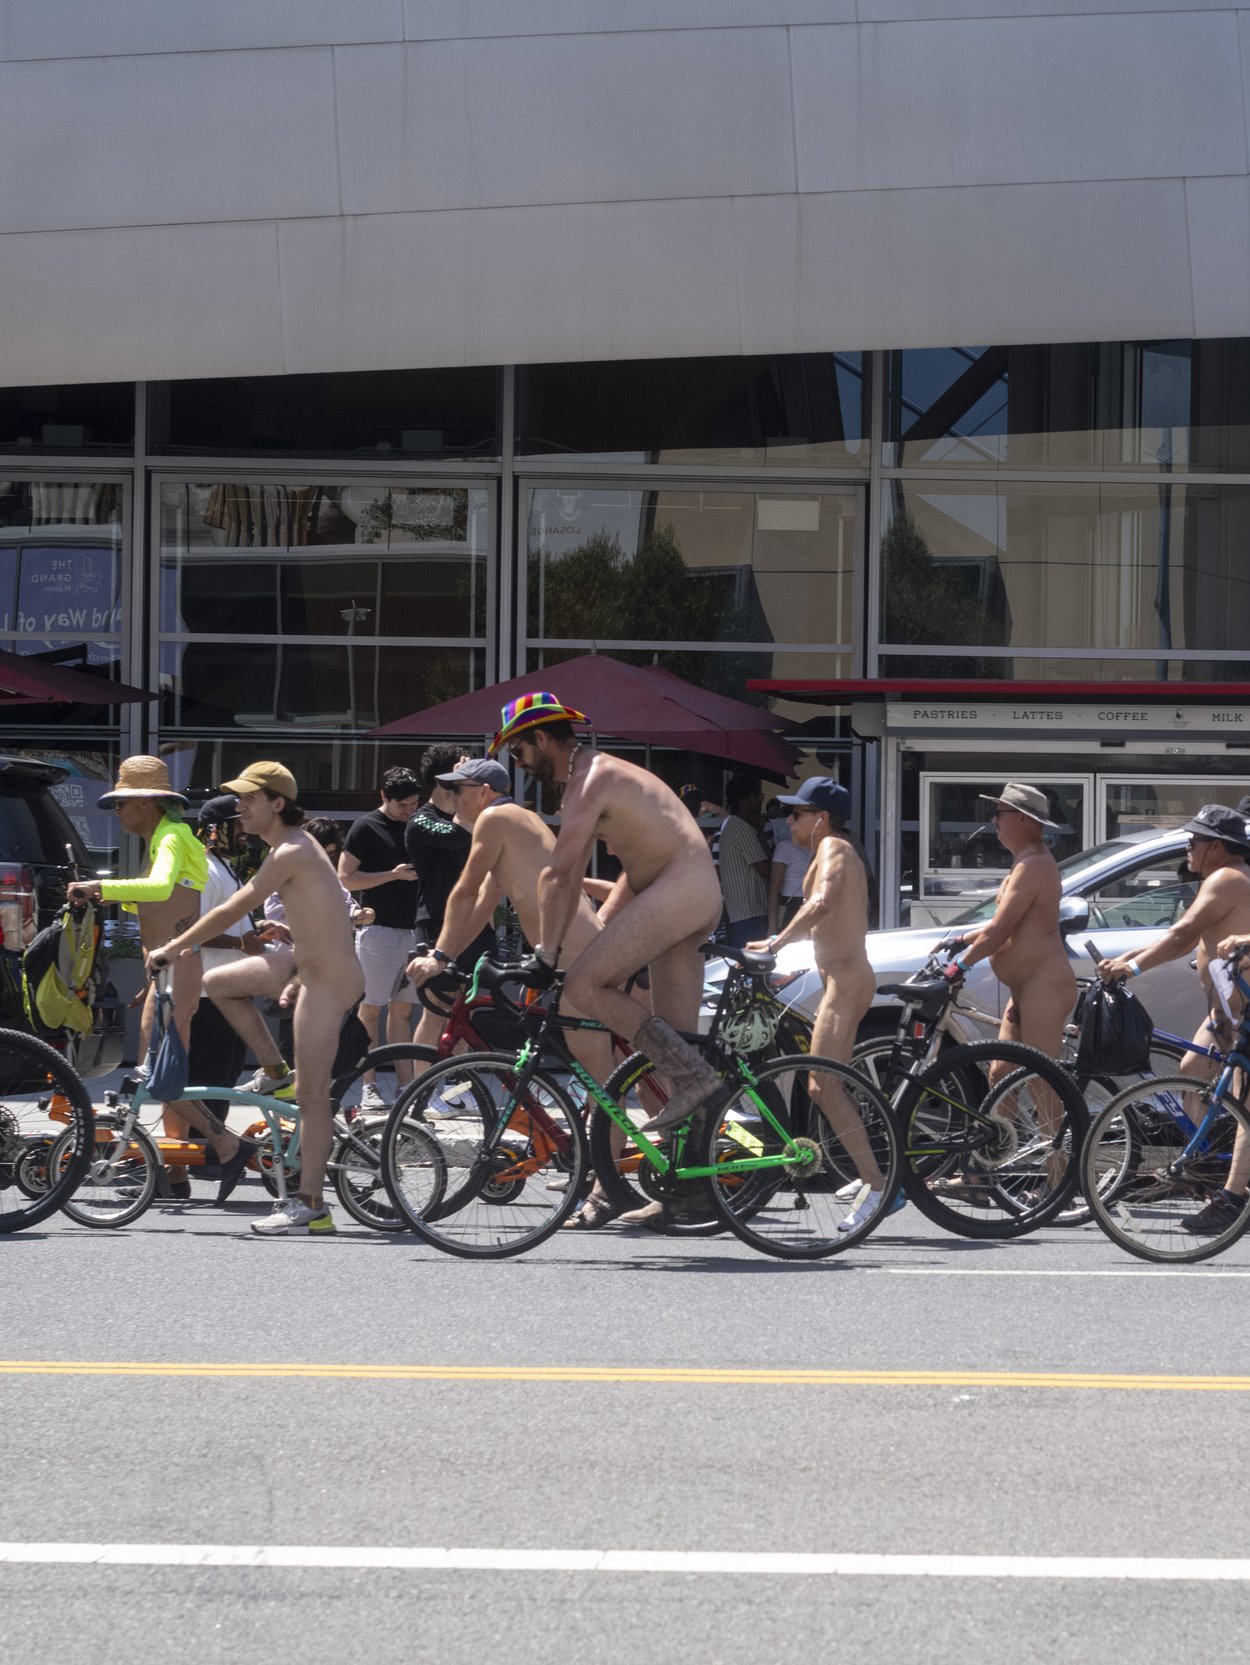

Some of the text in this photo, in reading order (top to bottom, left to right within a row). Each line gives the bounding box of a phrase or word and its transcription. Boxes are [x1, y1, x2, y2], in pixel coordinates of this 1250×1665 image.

[913, 710, 978, 720] PASTRIES
[1012, 711, 1063, 720] LATTES
[1098, 712, 1148, 721] COFFEE
[1211, 713, 1244, 722] MILK
